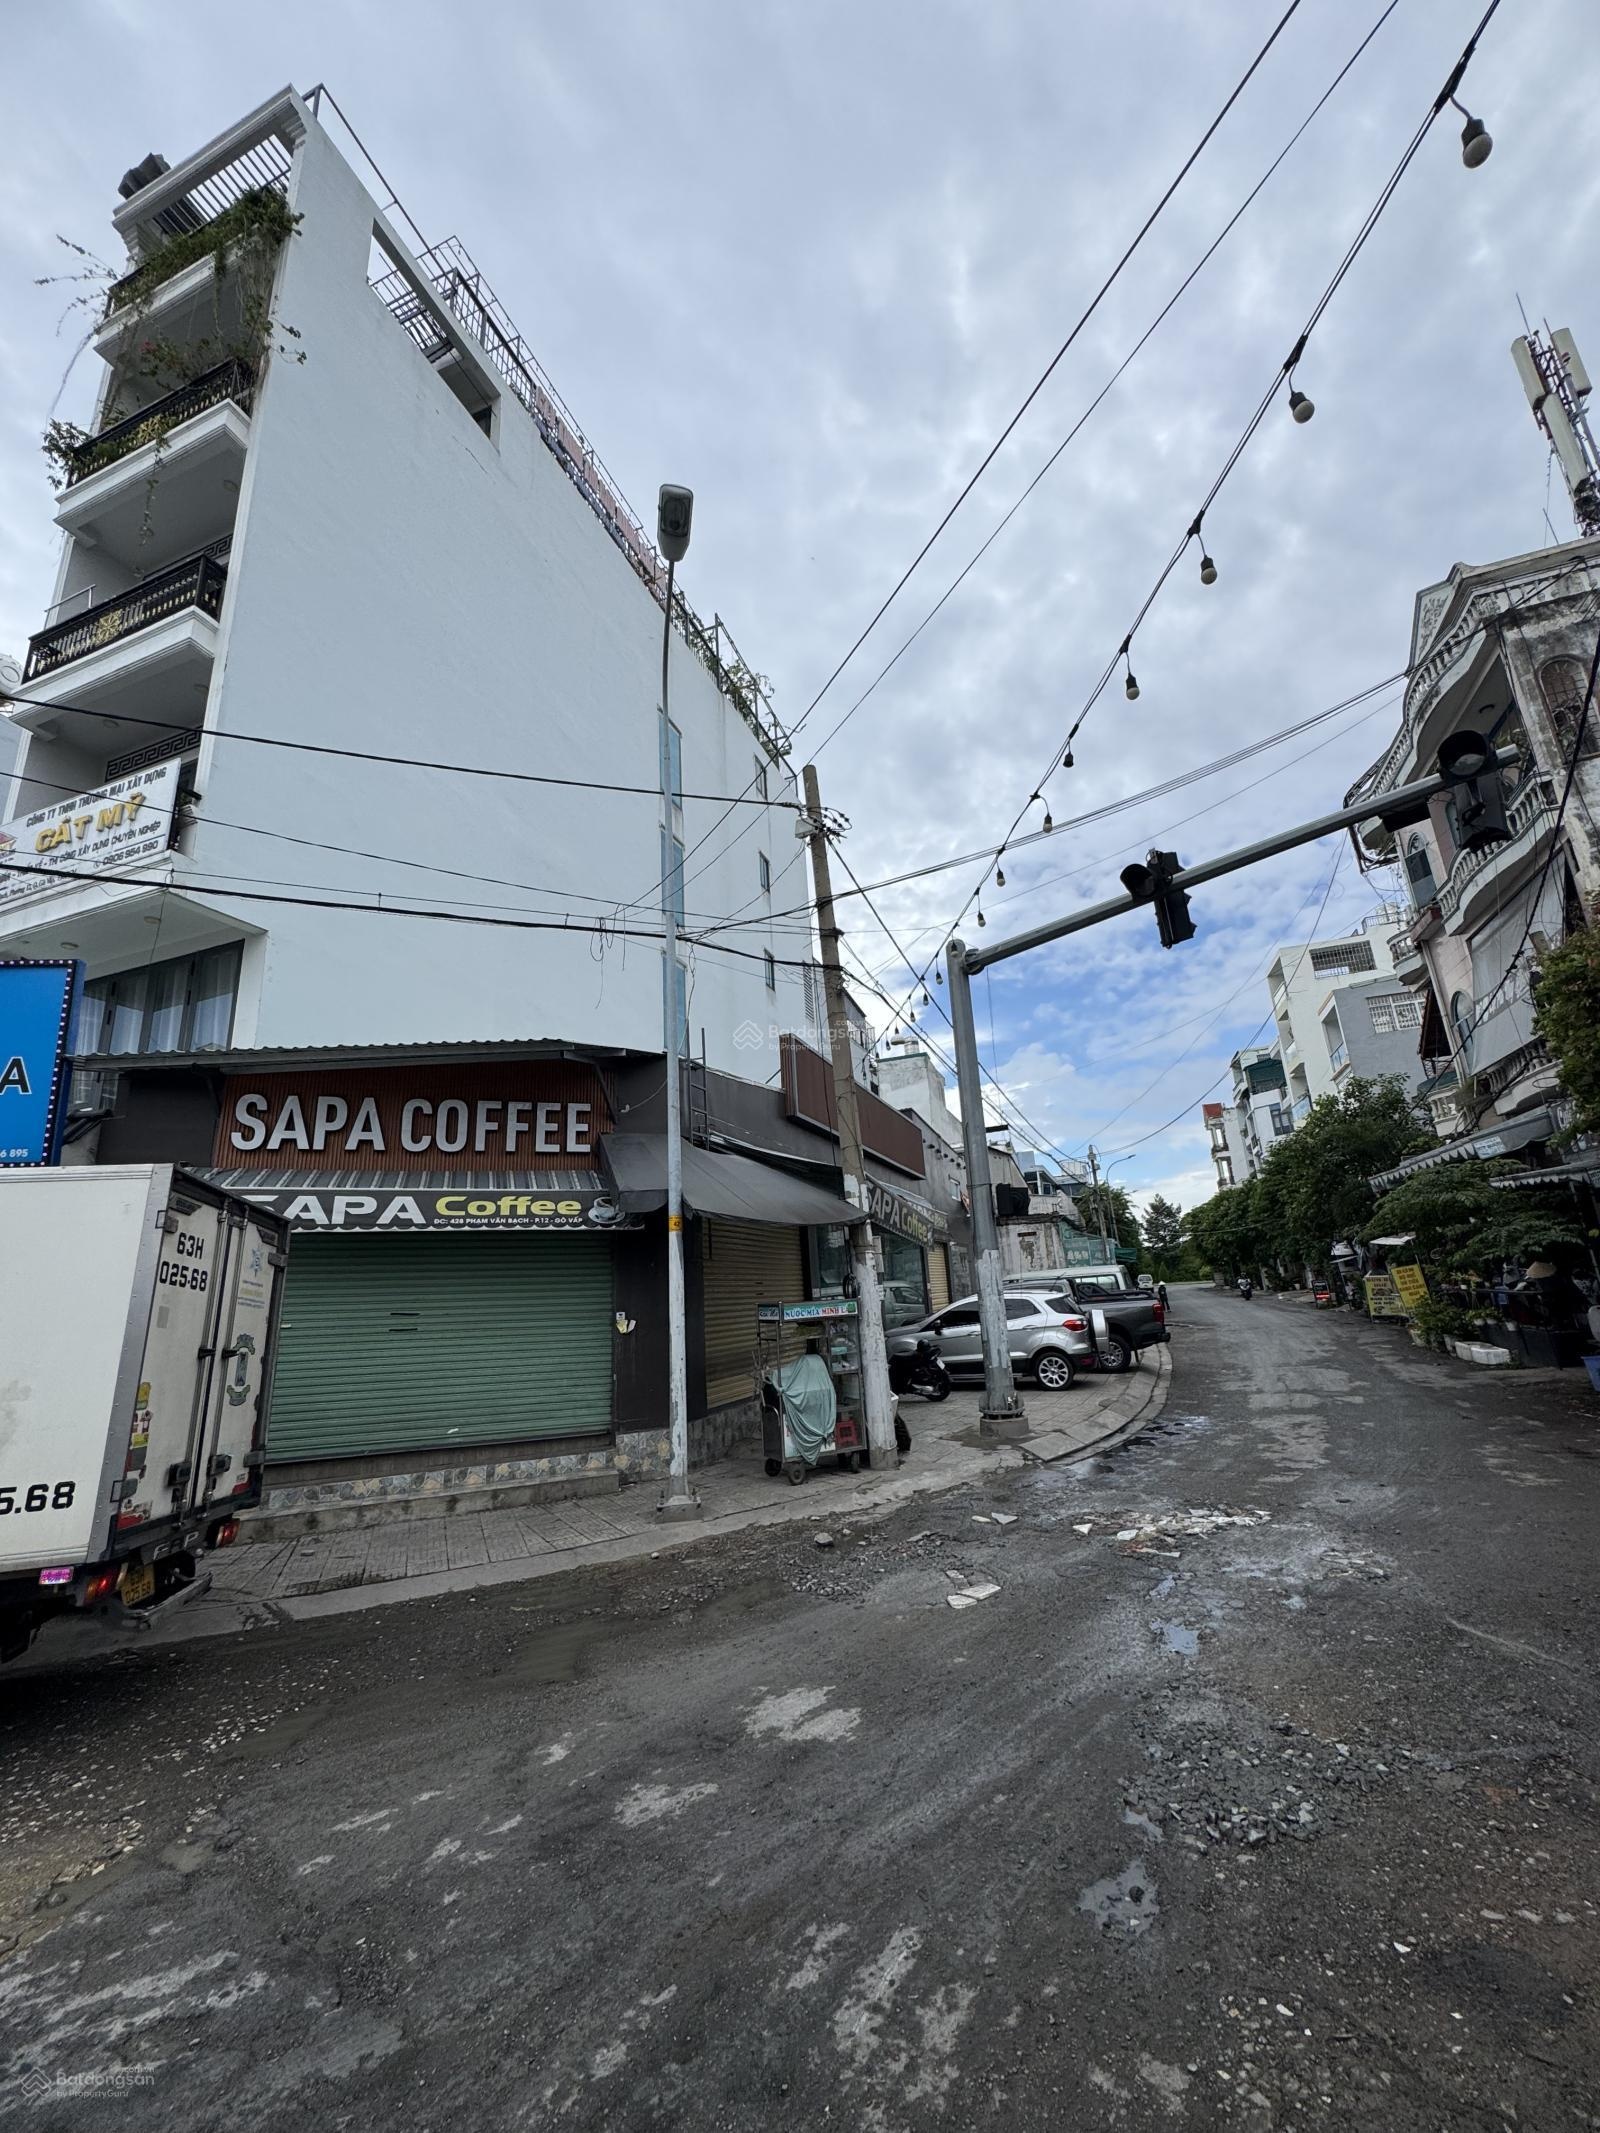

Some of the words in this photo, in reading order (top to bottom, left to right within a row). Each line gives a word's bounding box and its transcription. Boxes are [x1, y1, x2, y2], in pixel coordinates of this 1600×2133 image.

[126, 775, 142, 791] XÂY
[231, 1093, 386, 1151] SAPA
[401, 1098, 592, 1153] COFFEE
[9, 1148, 29, 1158] 895
[436, 1195, 582, 1216] Coffee
[177, 1232, 205, 1260] 63H
